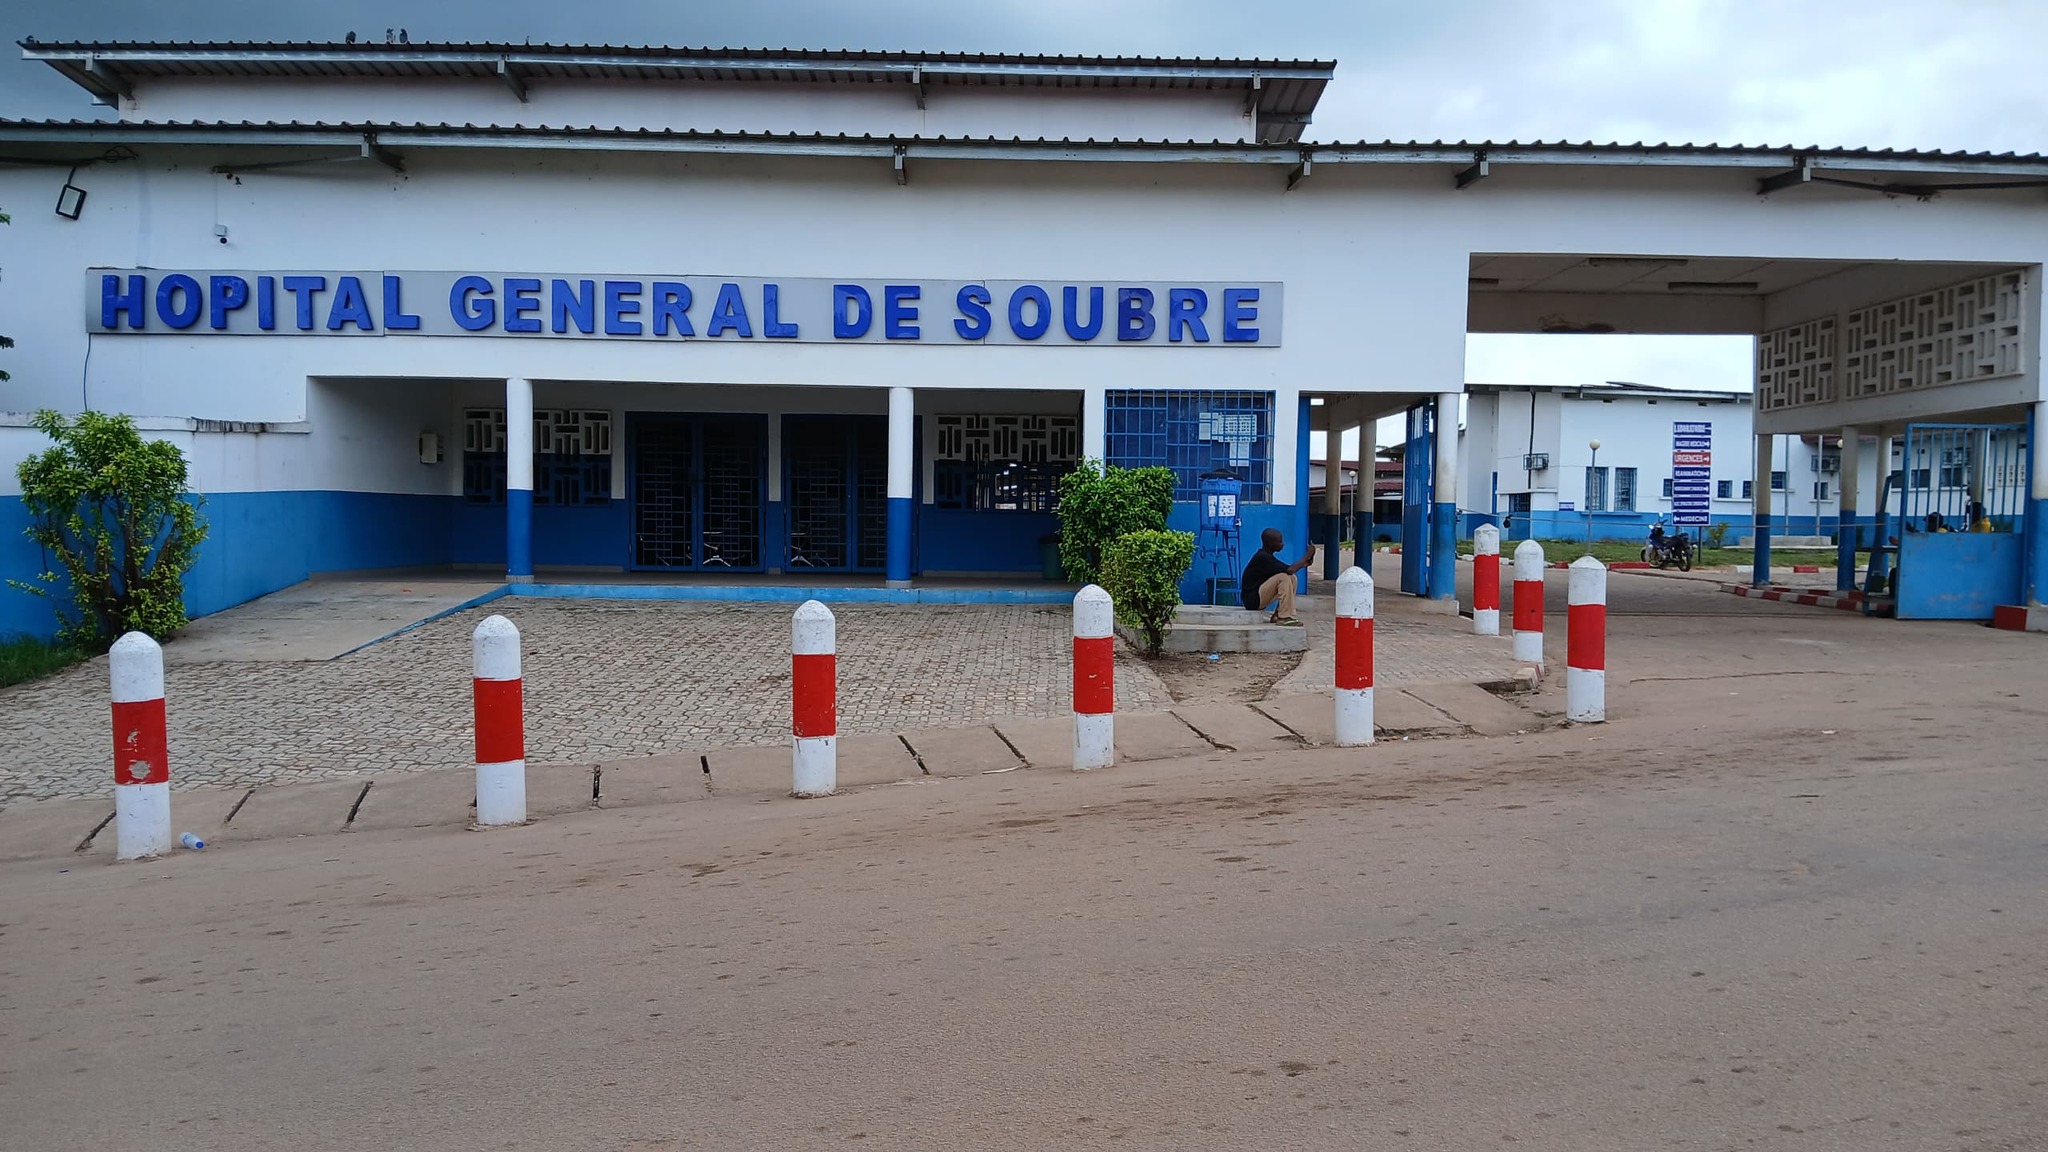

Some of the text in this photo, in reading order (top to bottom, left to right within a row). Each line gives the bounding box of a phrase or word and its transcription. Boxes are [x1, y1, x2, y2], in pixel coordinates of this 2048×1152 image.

[101, 274, 1260, 343] HOPITAL GENERAL DE SOUBRE
[1674, 454, 1703, 463] URGENCES
